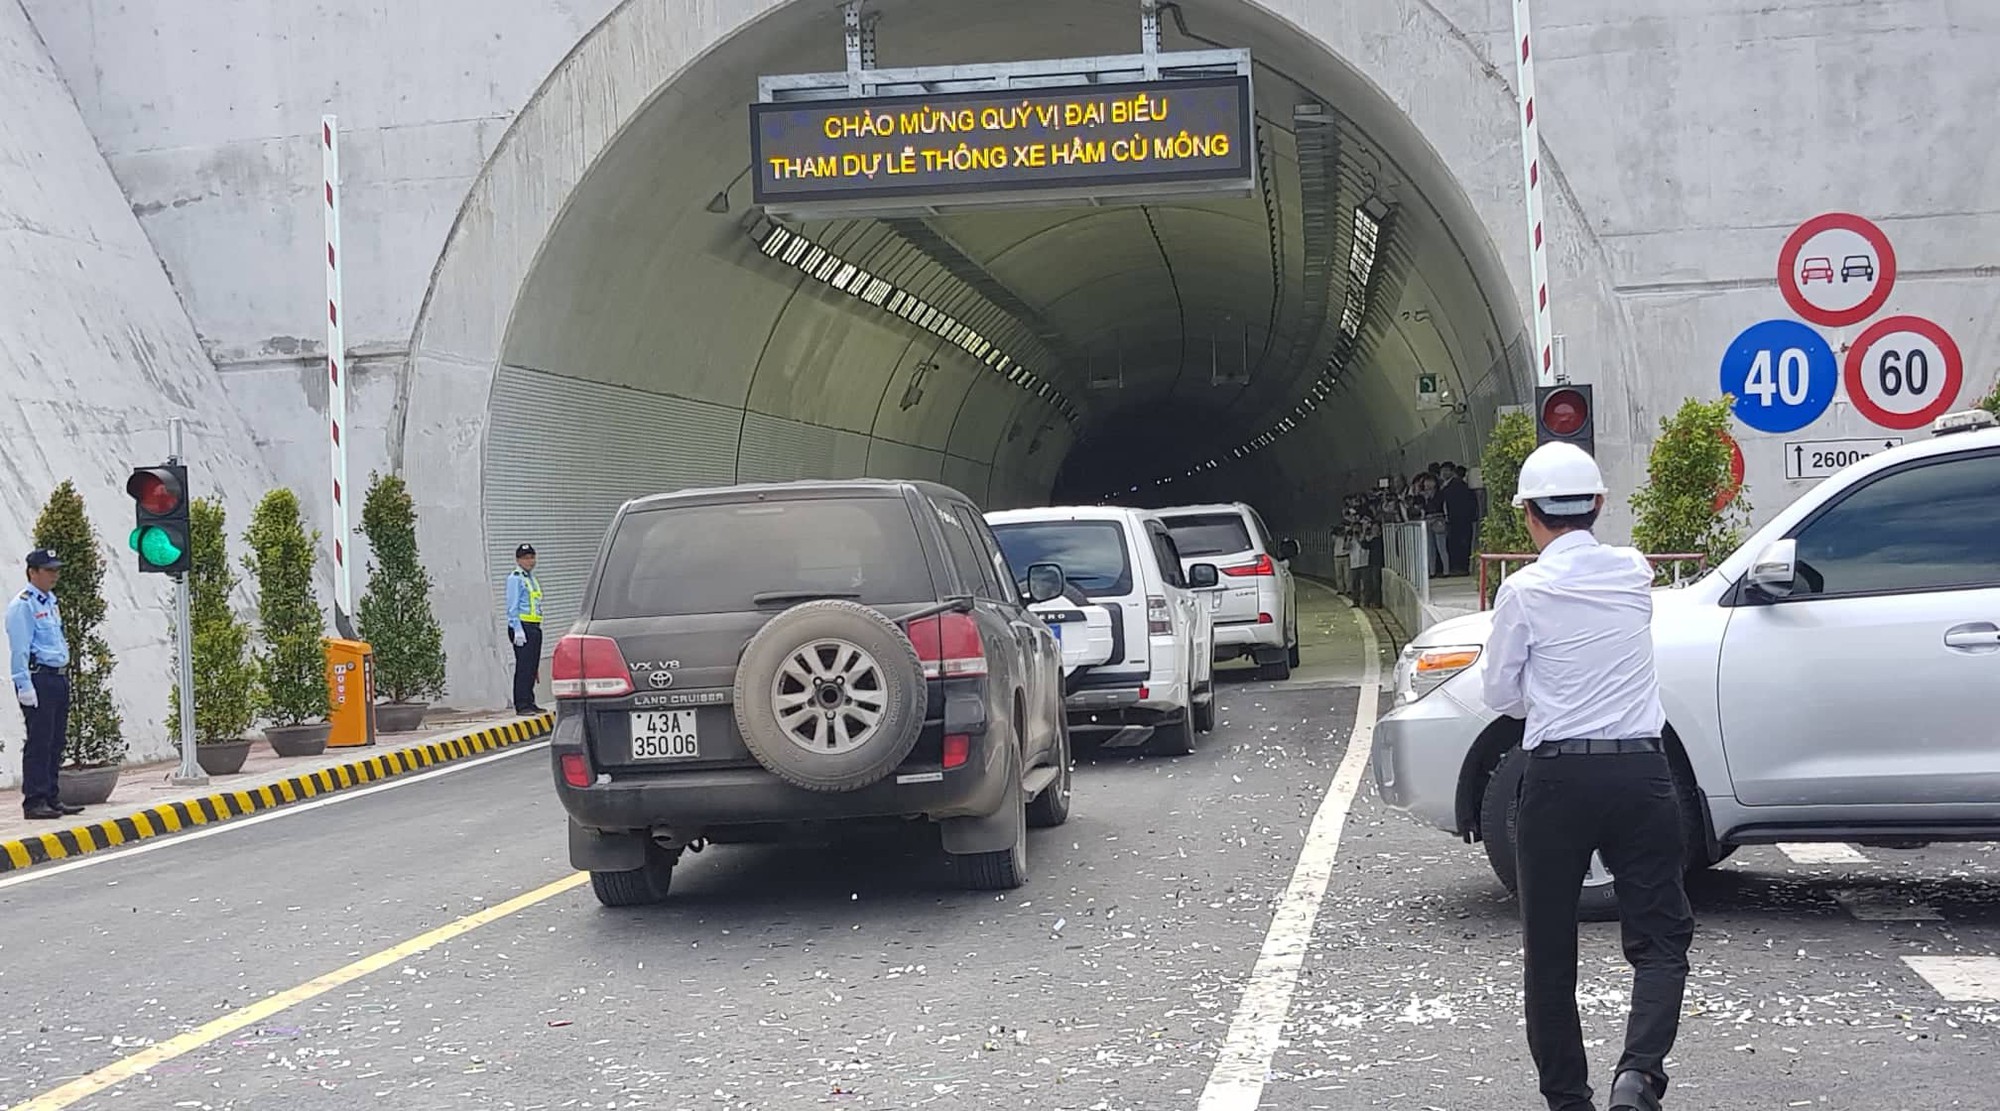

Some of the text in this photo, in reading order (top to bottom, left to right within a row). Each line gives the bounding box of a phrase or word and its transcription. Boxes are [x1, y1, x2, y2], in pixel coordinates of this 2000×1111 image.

[824, 93, 1167, 139] CHÀO MỪNG QUÝ VỊ ĐẠI BIỂU
[769, 155, 838, 180] THAM
[843, 152, 883, 180] DỰ
[886, 146, 917, 174] LỄ
[921, 142, 1008, 171] THÔNG
[1013, 144, 1046, 168] XE
[1111, 133, 1148, 162] CÙ
[1154, 130, 1230, 160] MÔNG
[1744, 348, 1810, 407] 40
[1879, 349, 1929, 396] 60
[630, 660, 680, 670] VX V8
[634, 693, 724, 705] LAND CRUISER
[647, 712, 681, 734] 43A
[634, 734, 696, 756] 350.06
